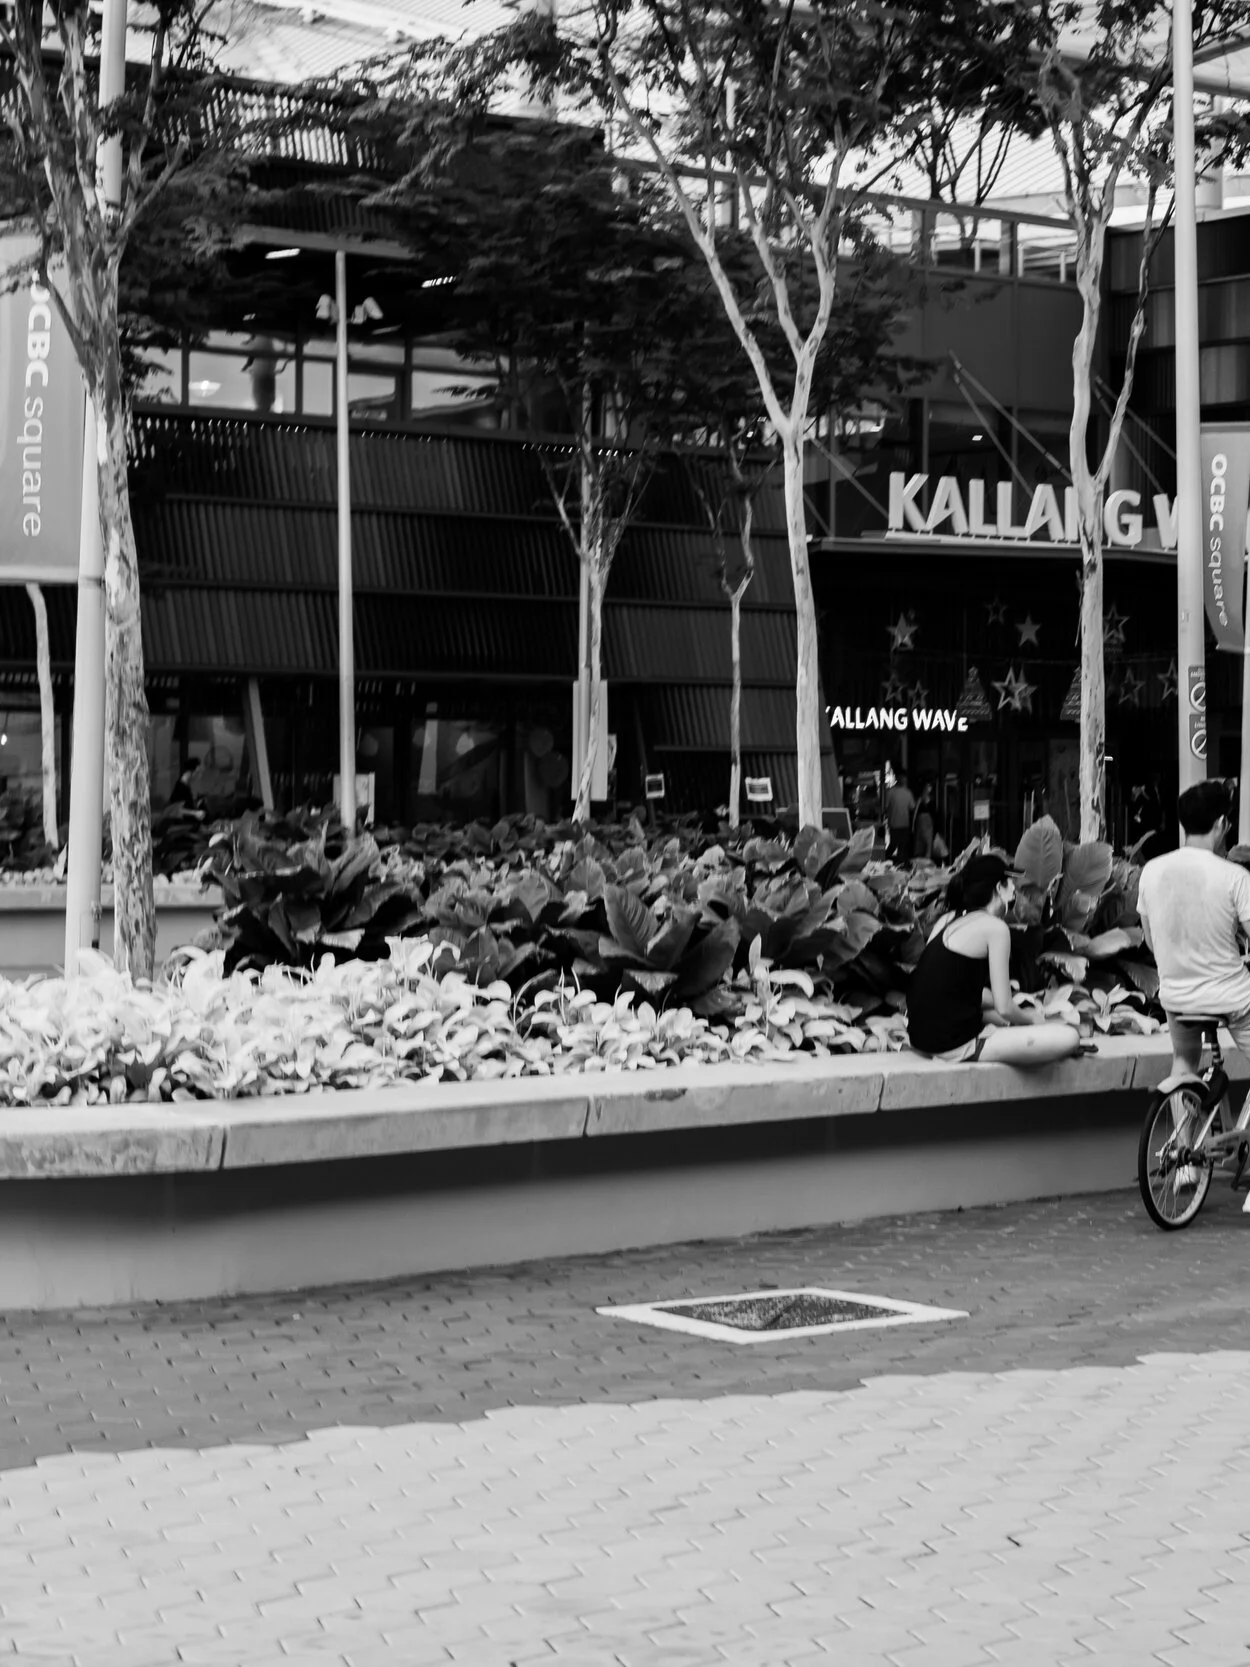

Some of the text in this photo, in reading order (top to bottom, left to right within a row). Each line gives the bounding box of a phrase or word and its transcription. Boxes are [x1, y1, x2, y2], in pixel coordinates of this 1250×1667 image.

[16, 396, 44, 537] square
[1208, 453, 1228, 627] OCBC square
[825, 705, 908, 731] ALLANG
